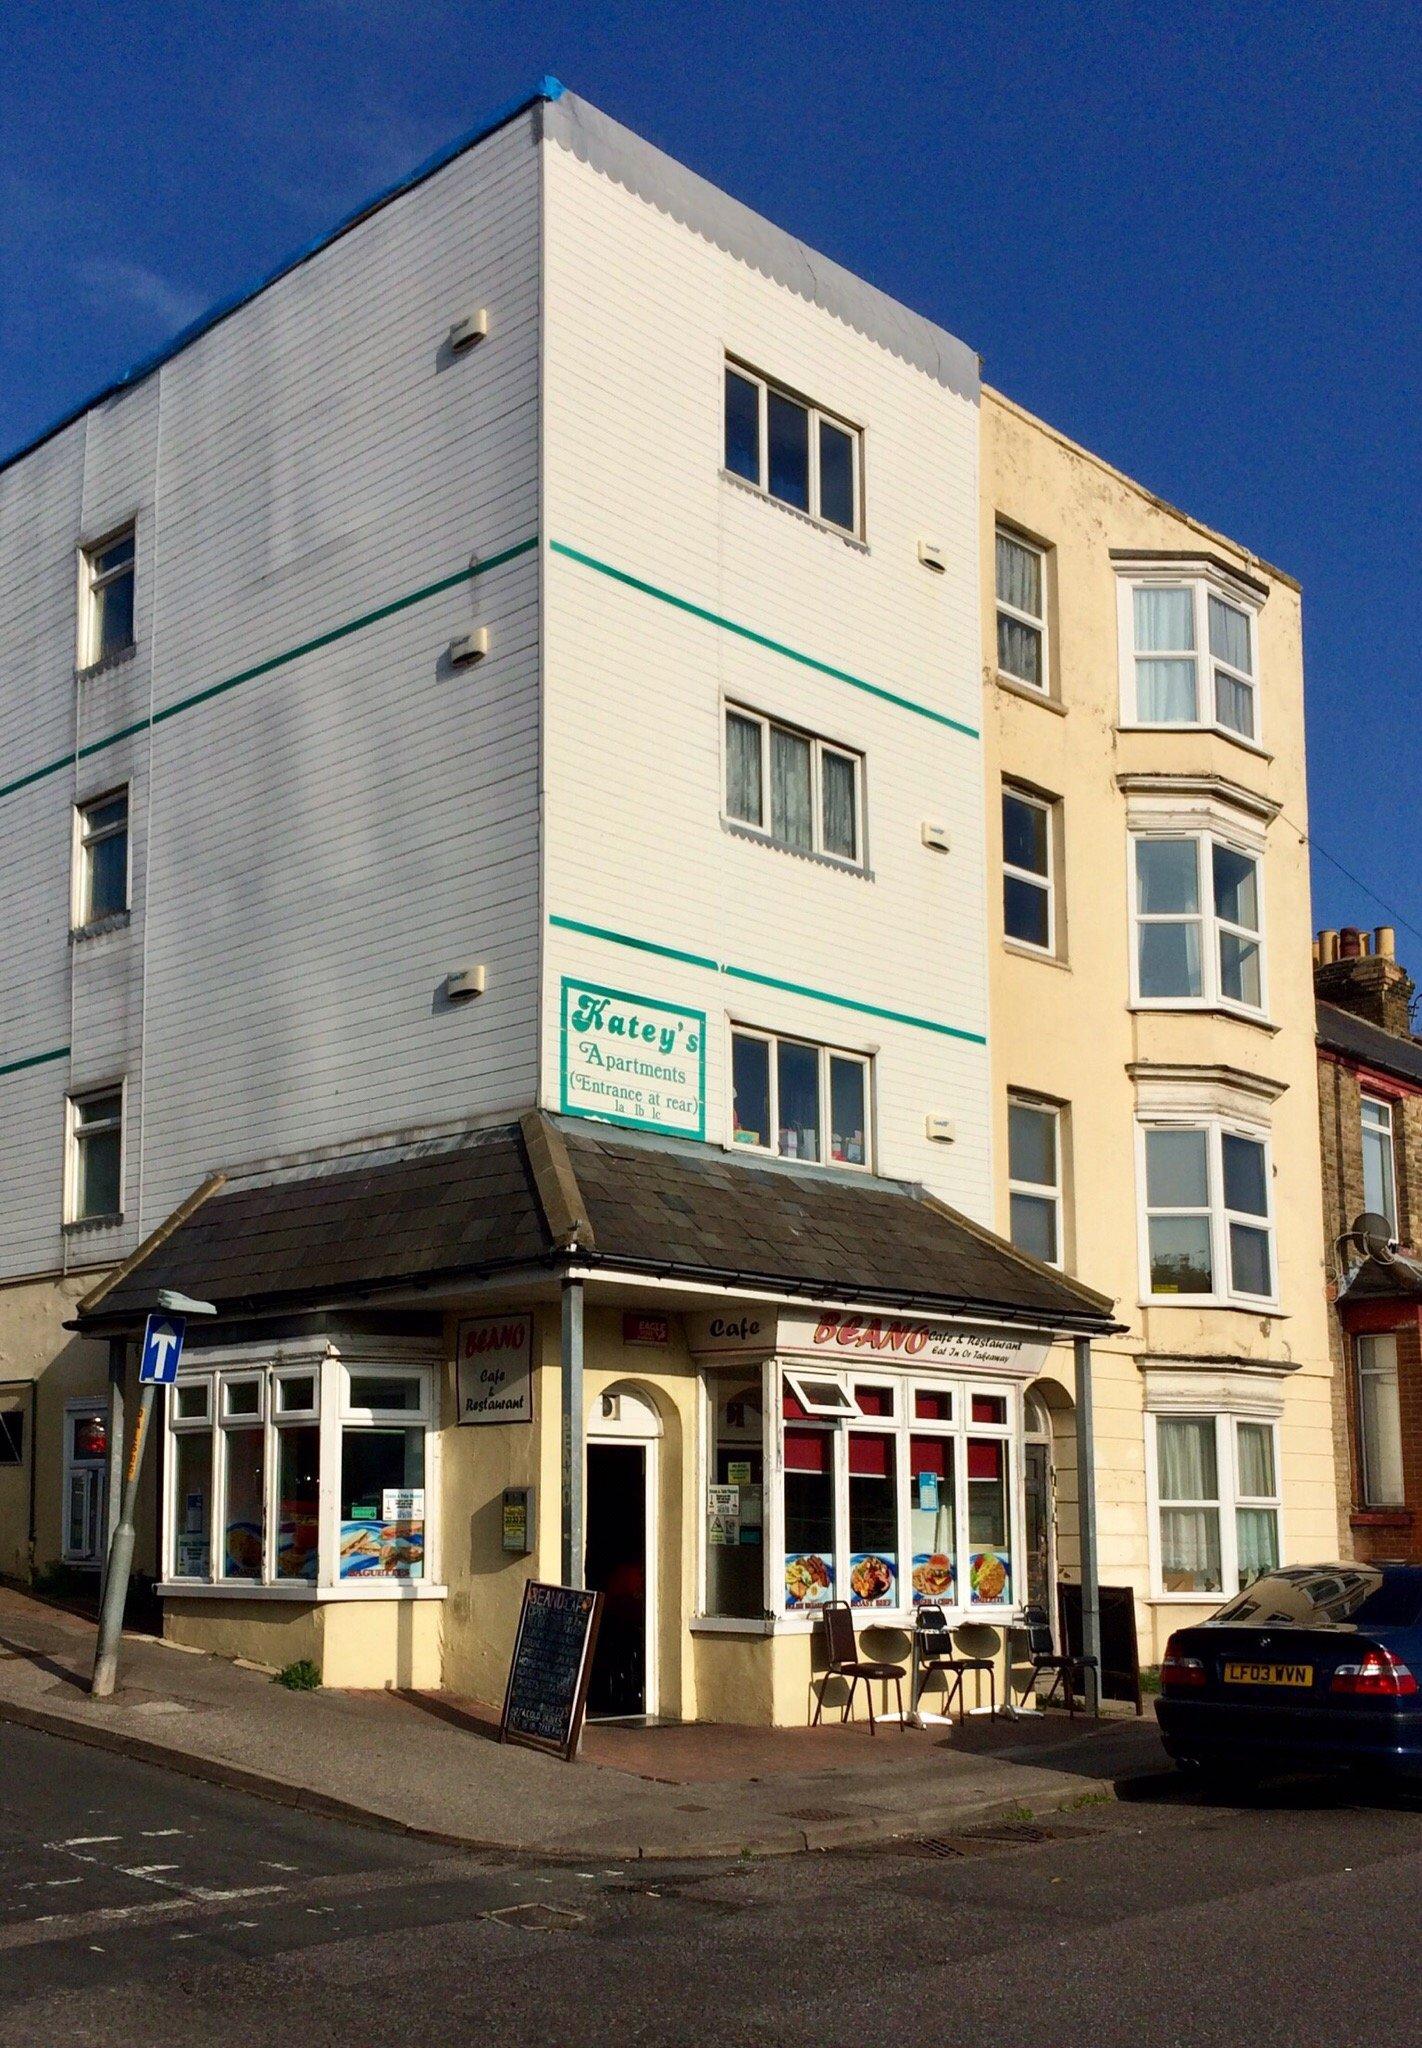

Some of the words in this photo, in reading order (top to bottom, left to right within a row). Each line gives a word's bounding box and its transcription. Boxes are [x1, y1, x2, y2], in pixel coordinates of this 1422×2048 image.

[571, 994, 699, 1054] Katey's
[579, 1041, 686, 1084] Apartments
[569, 1071, 643, 1102] (Entrance
[648, 1092, 661, 1106] at
[666, 1096, 699, 1115] rear)
[710, 1317, 760, 1340] Cafe
[814, 1311, 929, 1355] BEANO
[465, 1323, 526, 1359] BEANO
[929, 1330, 953, 1344] Cafe
[956, 1333, 963, 1344] &
[967, 1334, 1022, 1350] Restaurant
[932, 1347, 946, 1355] Eat
[949, 1348, 960, 1357] In
[962, 1350, 971, 1358] Or
[973, 1351, 1010, 1364] Takeaway
[480, 1369, 505, 1385] Cafe
[465, 1395, 524, 1411] Restaurant
[850, 1599, 873, 1607] ROAST
[1230, 1665, 1270, 1681] LF03
[1275, 1667, 1307, 1683] WVN
